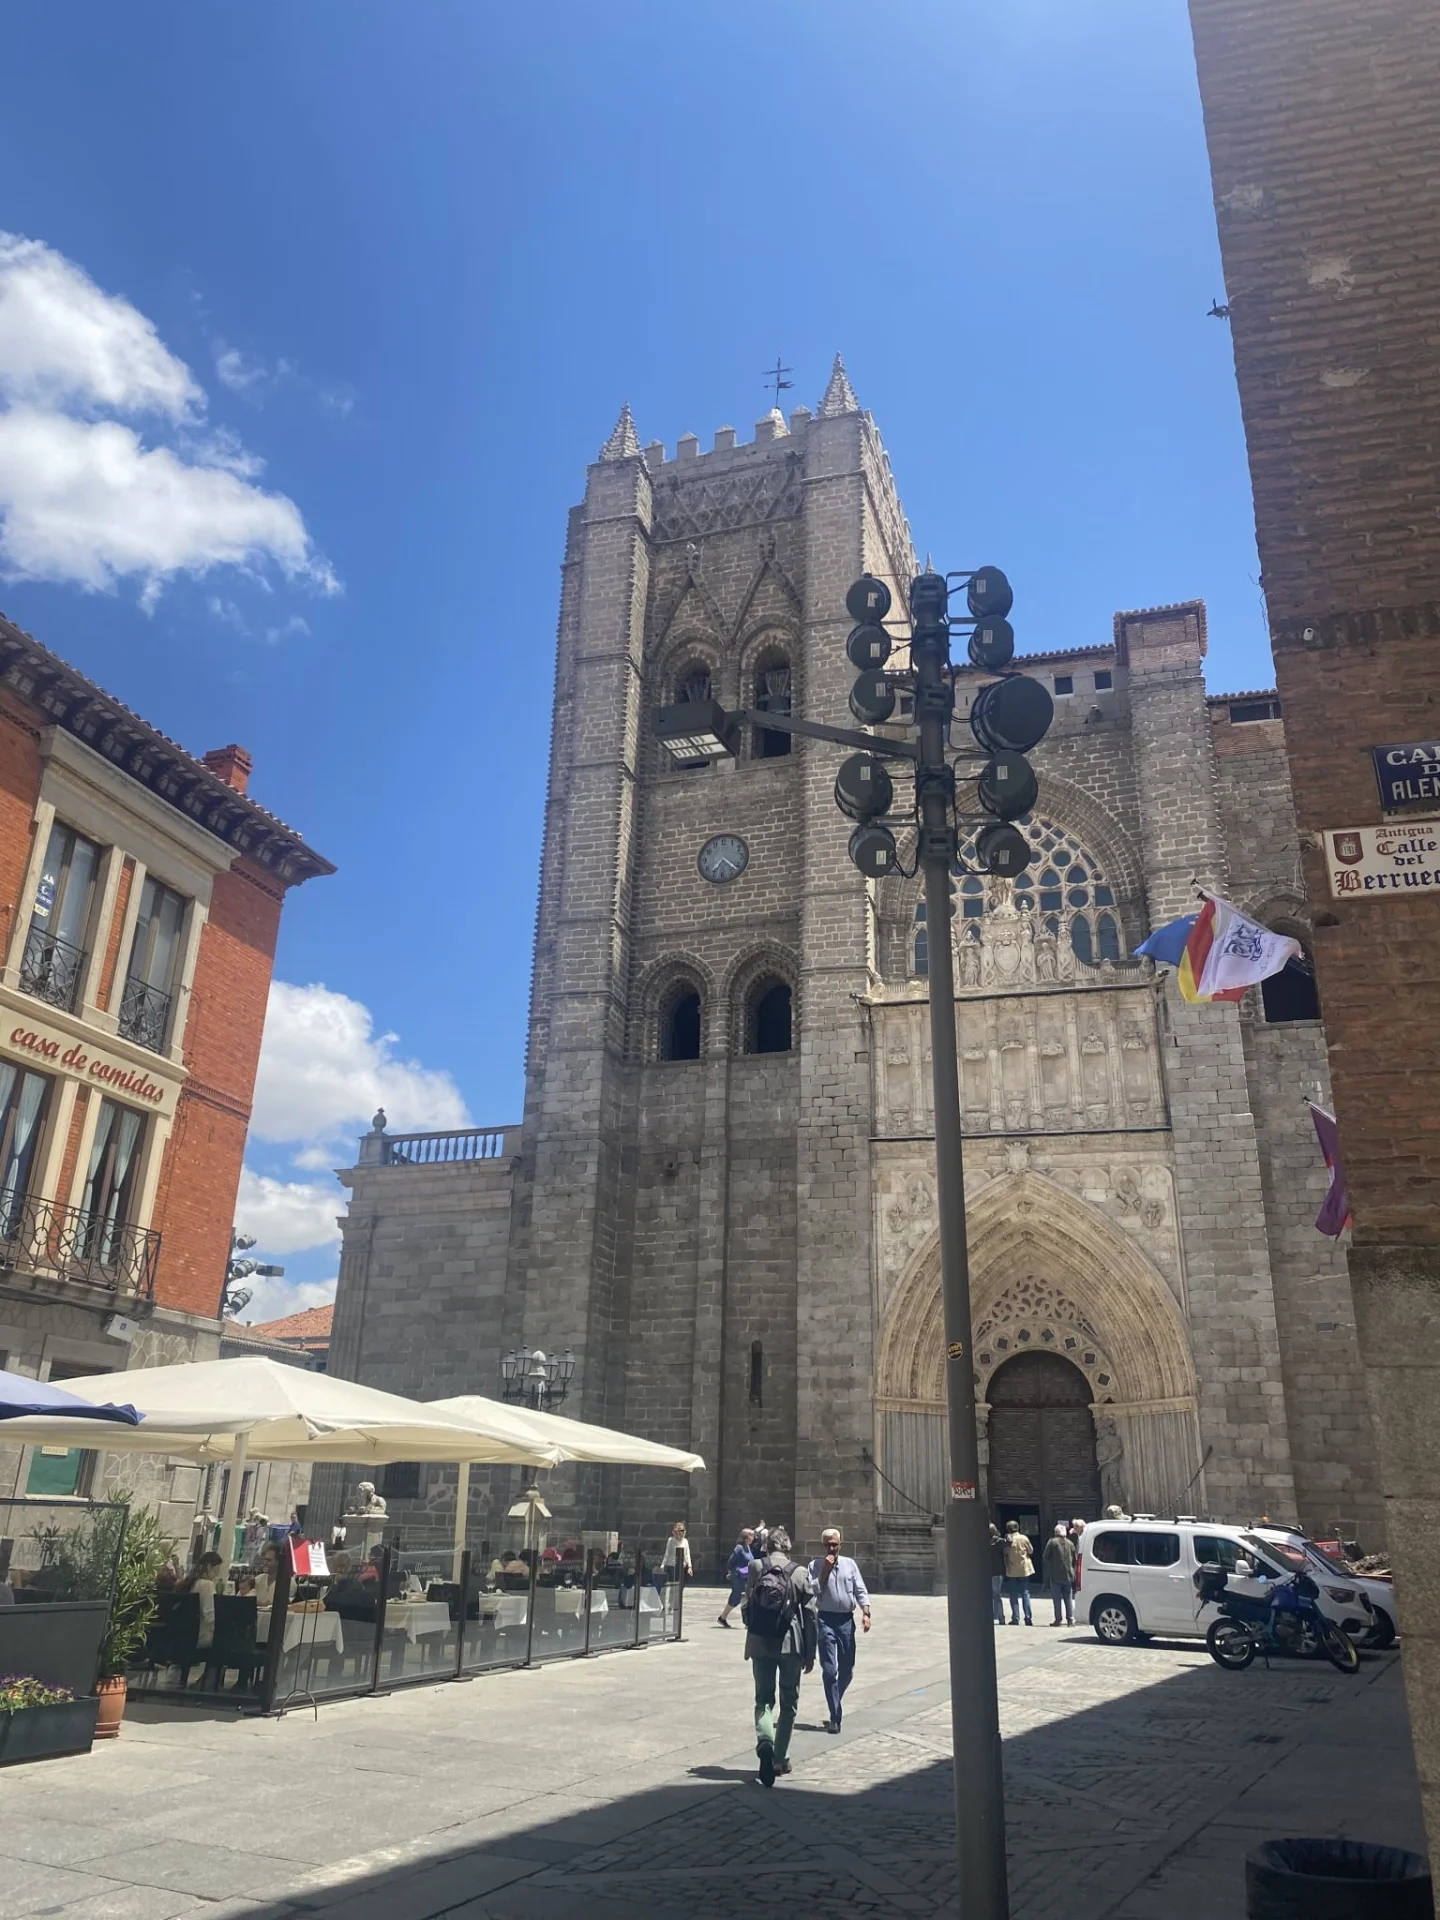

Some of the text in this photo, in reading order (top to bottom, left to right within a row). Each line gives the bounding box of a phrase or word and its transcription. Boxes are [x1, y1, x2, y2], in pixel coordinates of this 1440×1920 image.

[1375, 827, 1434, 839] Antigua
[1376, 838, 1438, 855] Calle
[1393, 854, 1425, 866] del
[10, 1027, 164, 1103] casa de comidas
